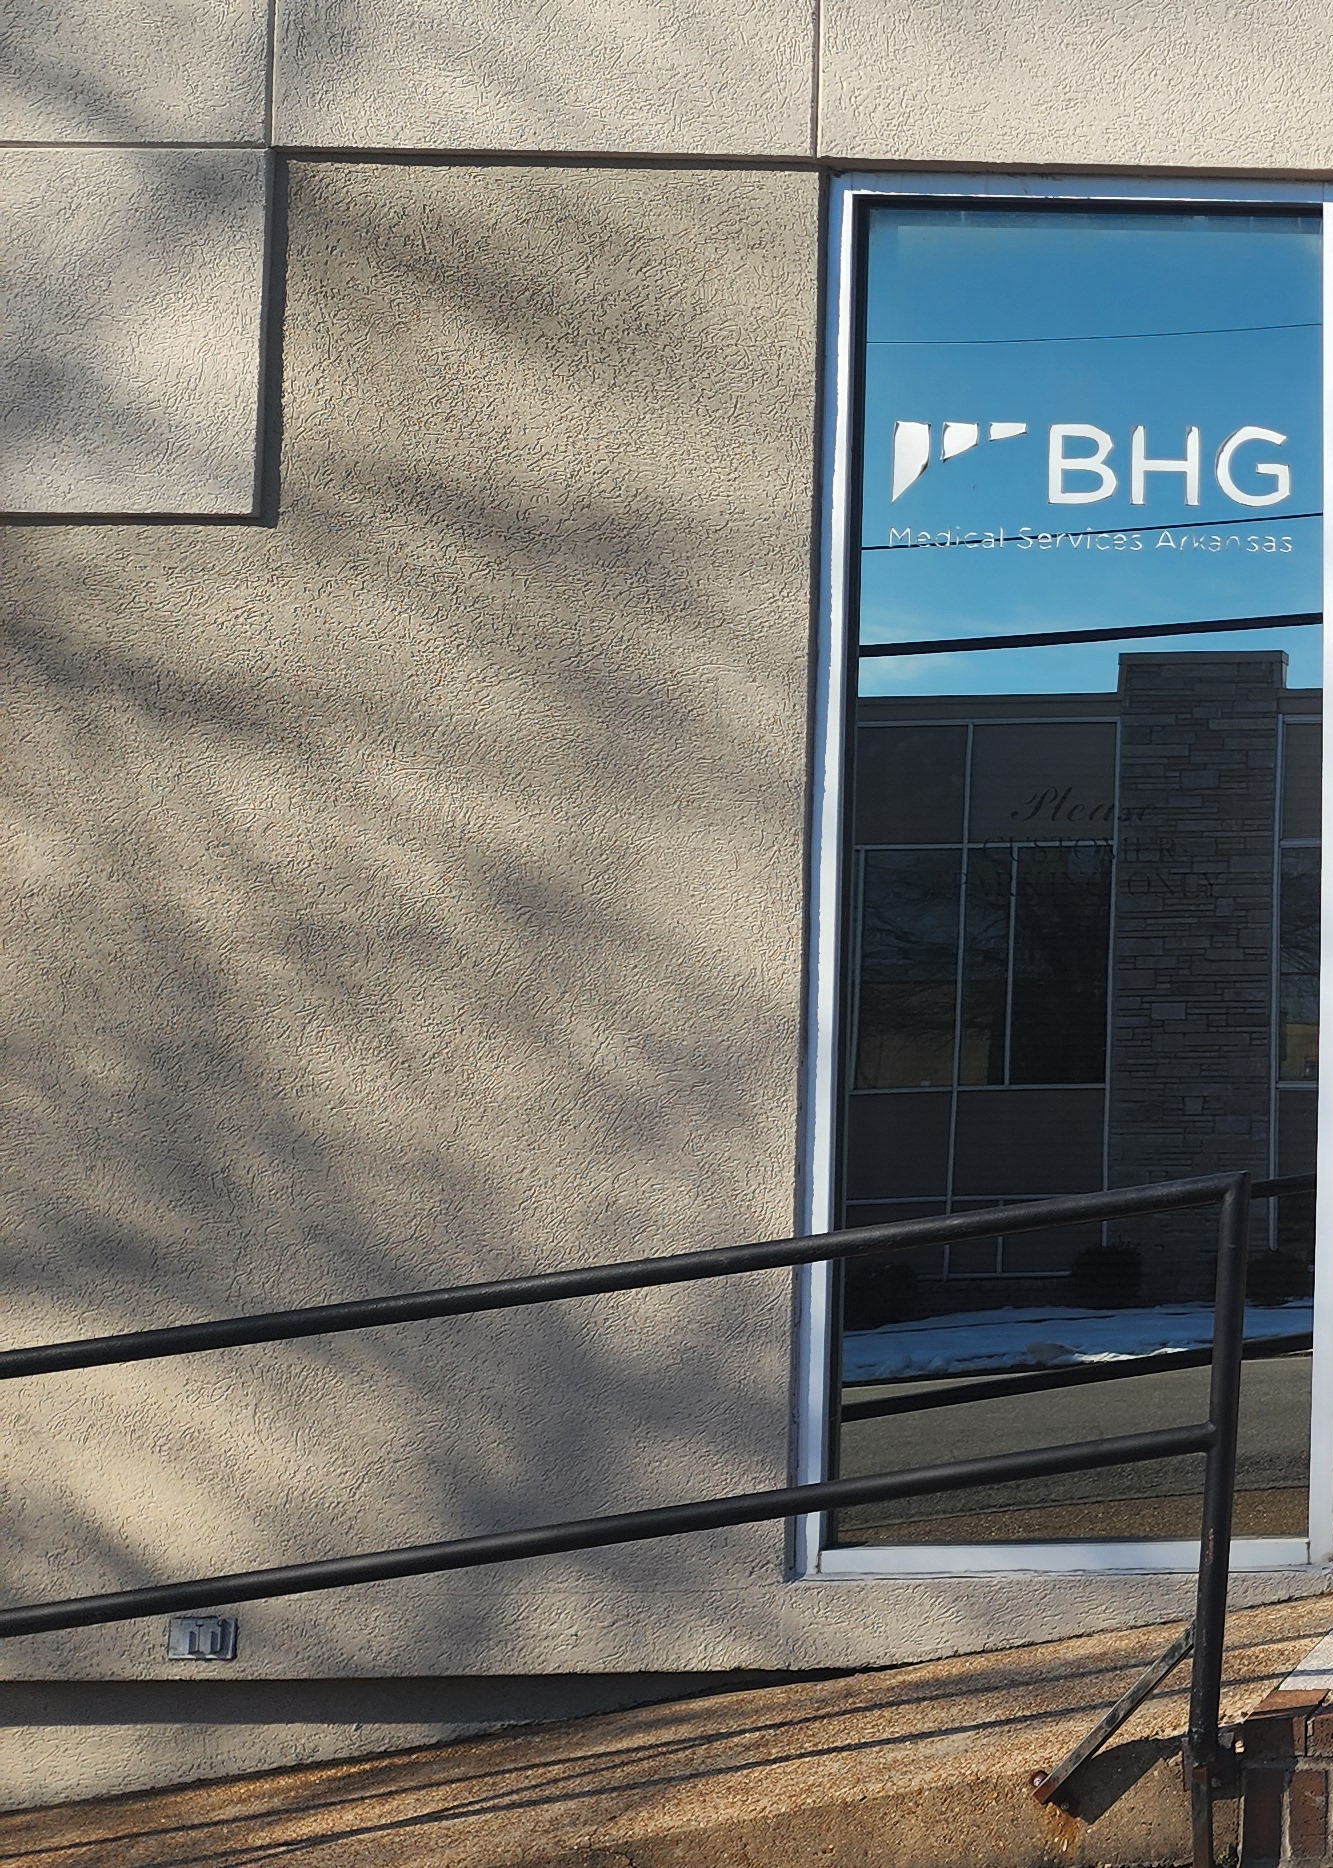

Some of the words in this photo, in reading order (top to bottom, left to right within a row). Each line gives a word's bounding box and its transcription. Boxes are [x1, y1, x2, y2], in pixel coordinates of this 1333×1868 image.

[1048, 423, 1291, 507] BHG
[888, 525, 1006, 550] Medical
[1016, 526, 1144, 552] Services
[1154, 529, 1294, 554] Arkansas
[1011, 786, 1157, 823] Please
